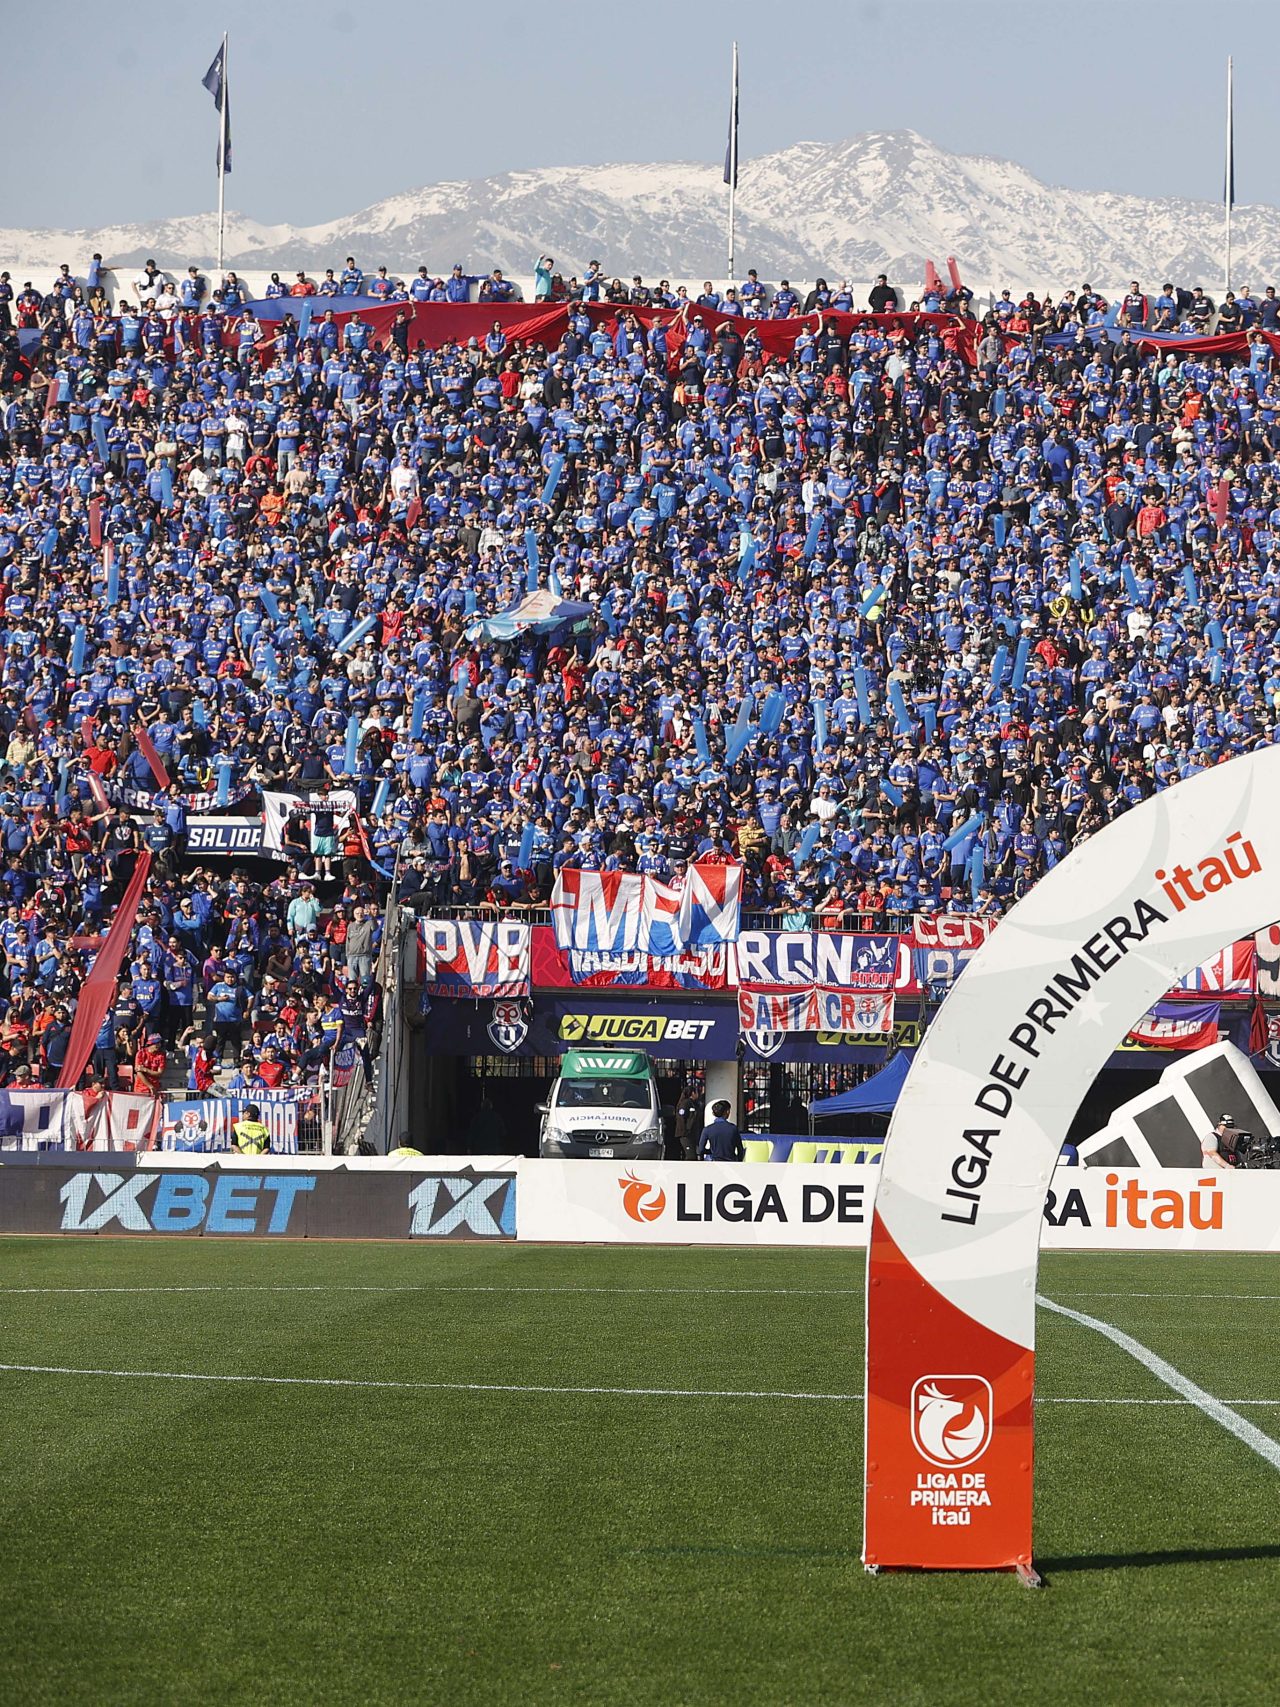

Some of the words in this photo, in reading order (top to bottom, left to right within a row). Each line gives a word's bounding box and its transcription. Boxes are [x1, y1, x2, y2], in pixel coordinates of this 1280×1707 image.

[740, 992, 821, 1031] SANTA
[941, 1128, 1001, 1226] LIGA
[974, 1053, 1030, 1118] DE
[1008, 898, 1169, 1058] PRIMERA
[1155, 831, 1262, 912] itaú
[60, 1173, 317, 1233] 1XBET
[408, 1176, 516, 1237] 1X
[676, 1183, 788, 1222] LIGA
[802, 1184, 864, 1223] DE
[1105, 1173, 1223, 1230] itaú
[911, 1491, 991, 1506] PRIMERA
[917, 1473, 958, 1488] LIGA
[962, 1473, 985, 1488] DE
[932, 1507, 970, 1525] itaú
